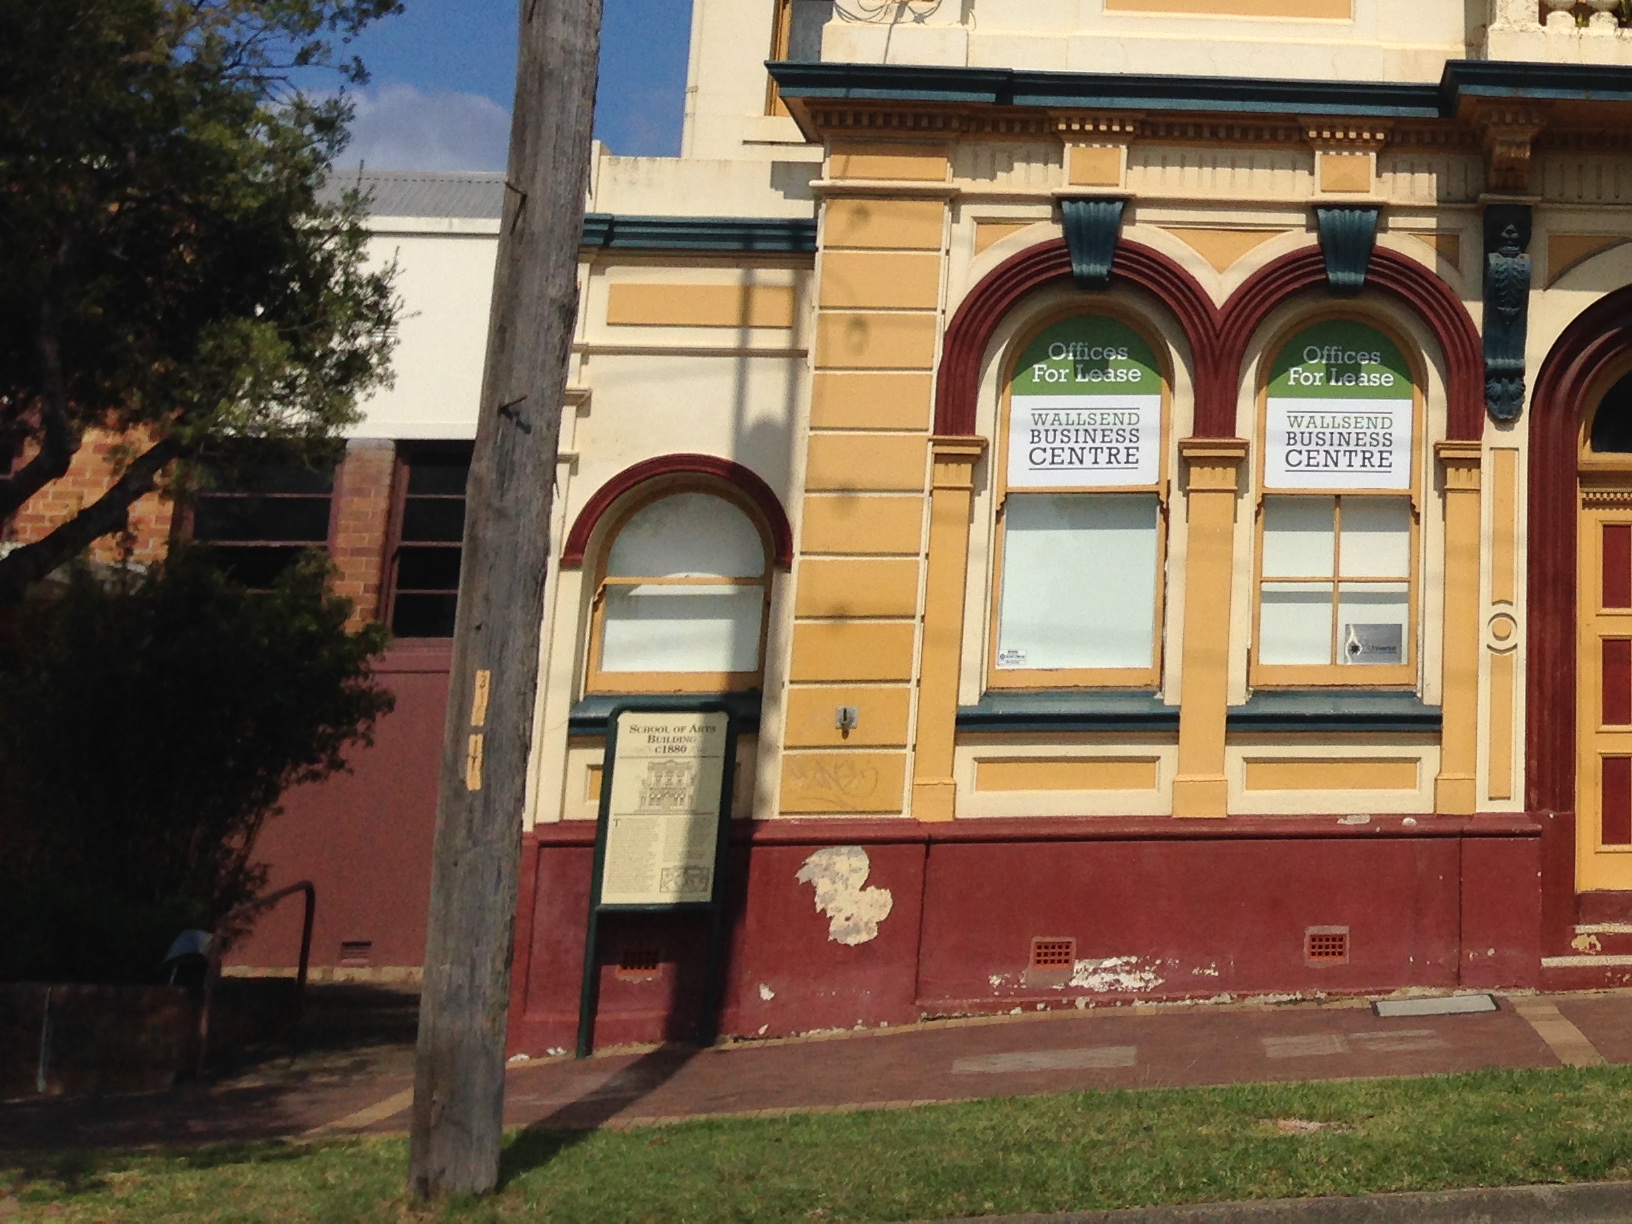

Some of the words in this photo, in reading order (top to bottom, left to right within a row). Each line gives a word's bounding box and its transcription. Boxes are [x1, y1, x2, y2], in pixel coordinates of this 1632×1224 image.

[1048, 341, 1128, 361] Offices
[1303, 345, 1381, 365] Offices
[1032, 365, 1070, 383] For
[1075, 365, 1141, 383] Lease
[1287, 368, 1321, 386] For
[1329, 369, 1394, 387] Lease
[1031, 412, 1140, 427] WALLSEND
[1287, 415, 1393, 430] WALLSEND
[1030, 429, 1140, 444] BUSINESS
[1286, 431, 1393, 447] BUSINESS
[1028, 446, 1139, 466] CENTRE
[1285, 449, 1392, 469] CENTRE
[689, 724, 717, 734] ARTS
[647, 735, 696, 744] BUILDING
